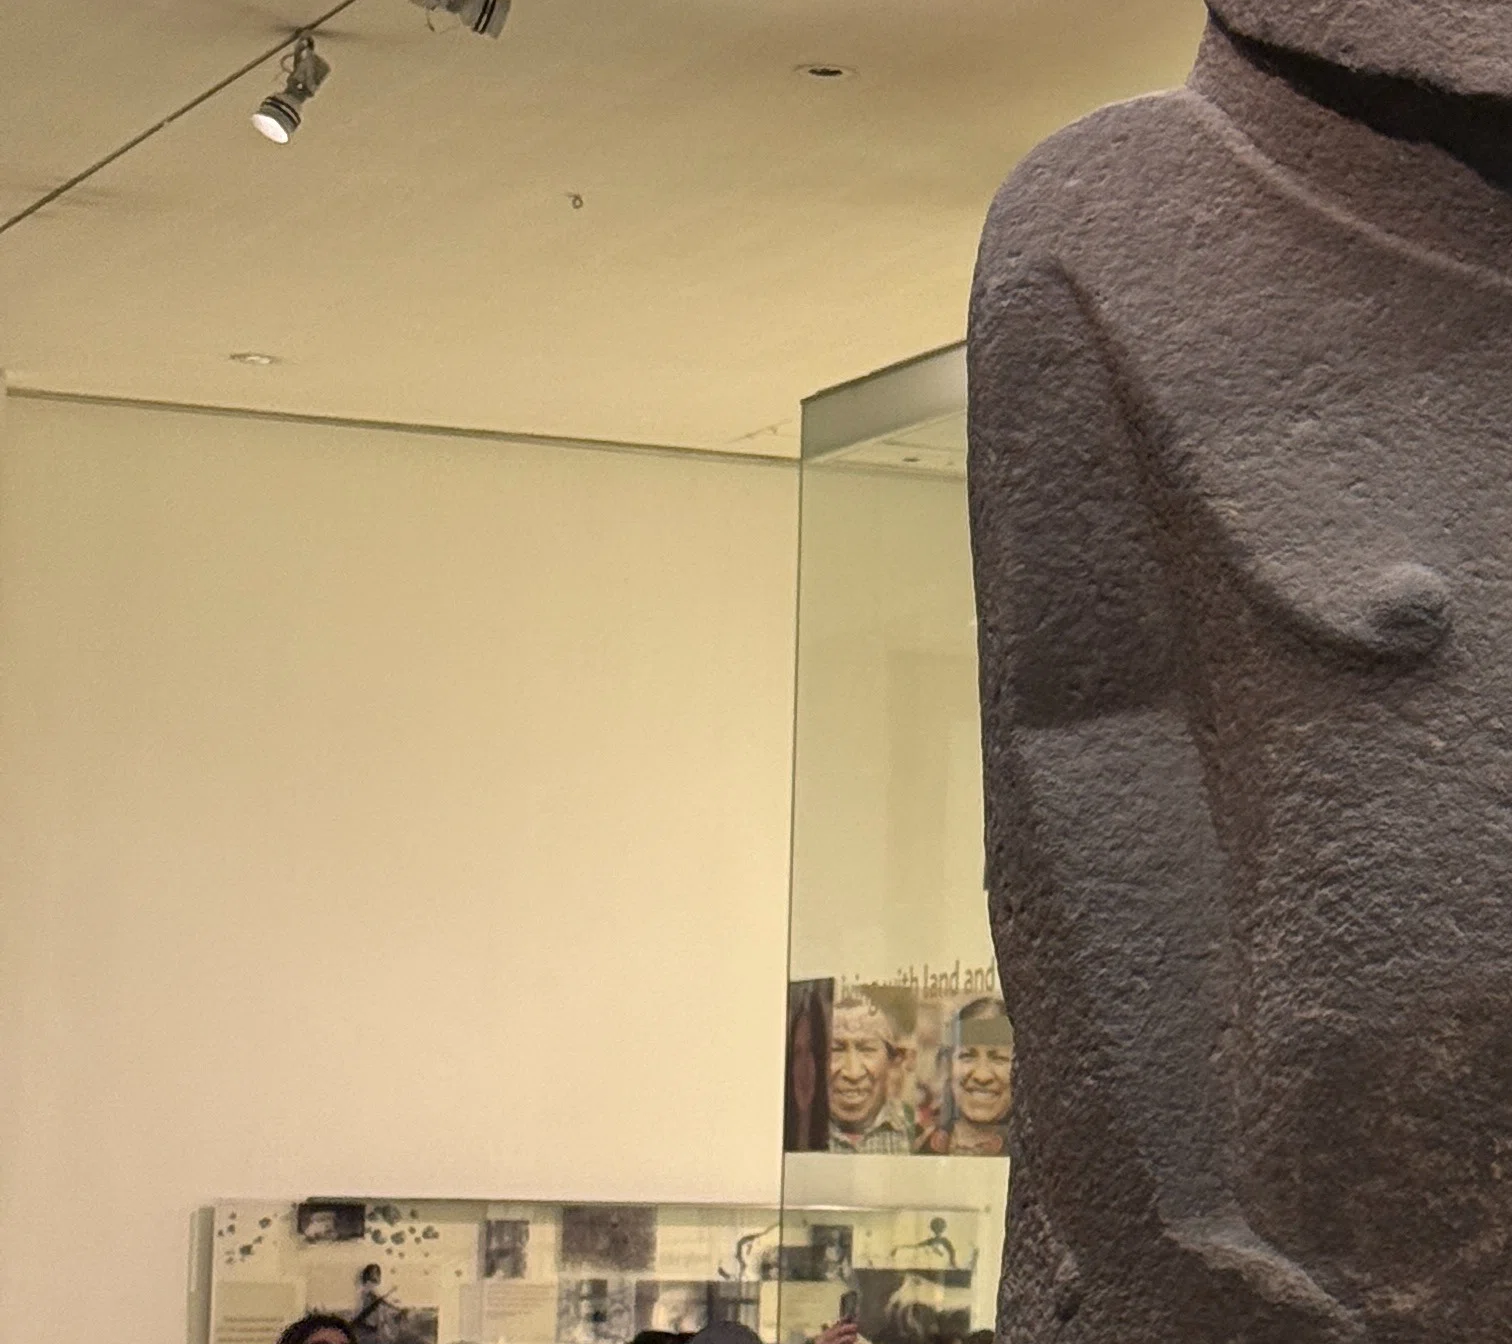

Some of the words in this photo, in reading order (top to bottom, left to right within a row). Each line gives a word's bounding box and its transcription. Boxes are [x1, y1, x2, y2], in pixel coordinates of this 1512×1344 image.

[879, 967, 918, 1002] ith
[923, 959, 960, 999] land
[963, 956, 995, 994] and
